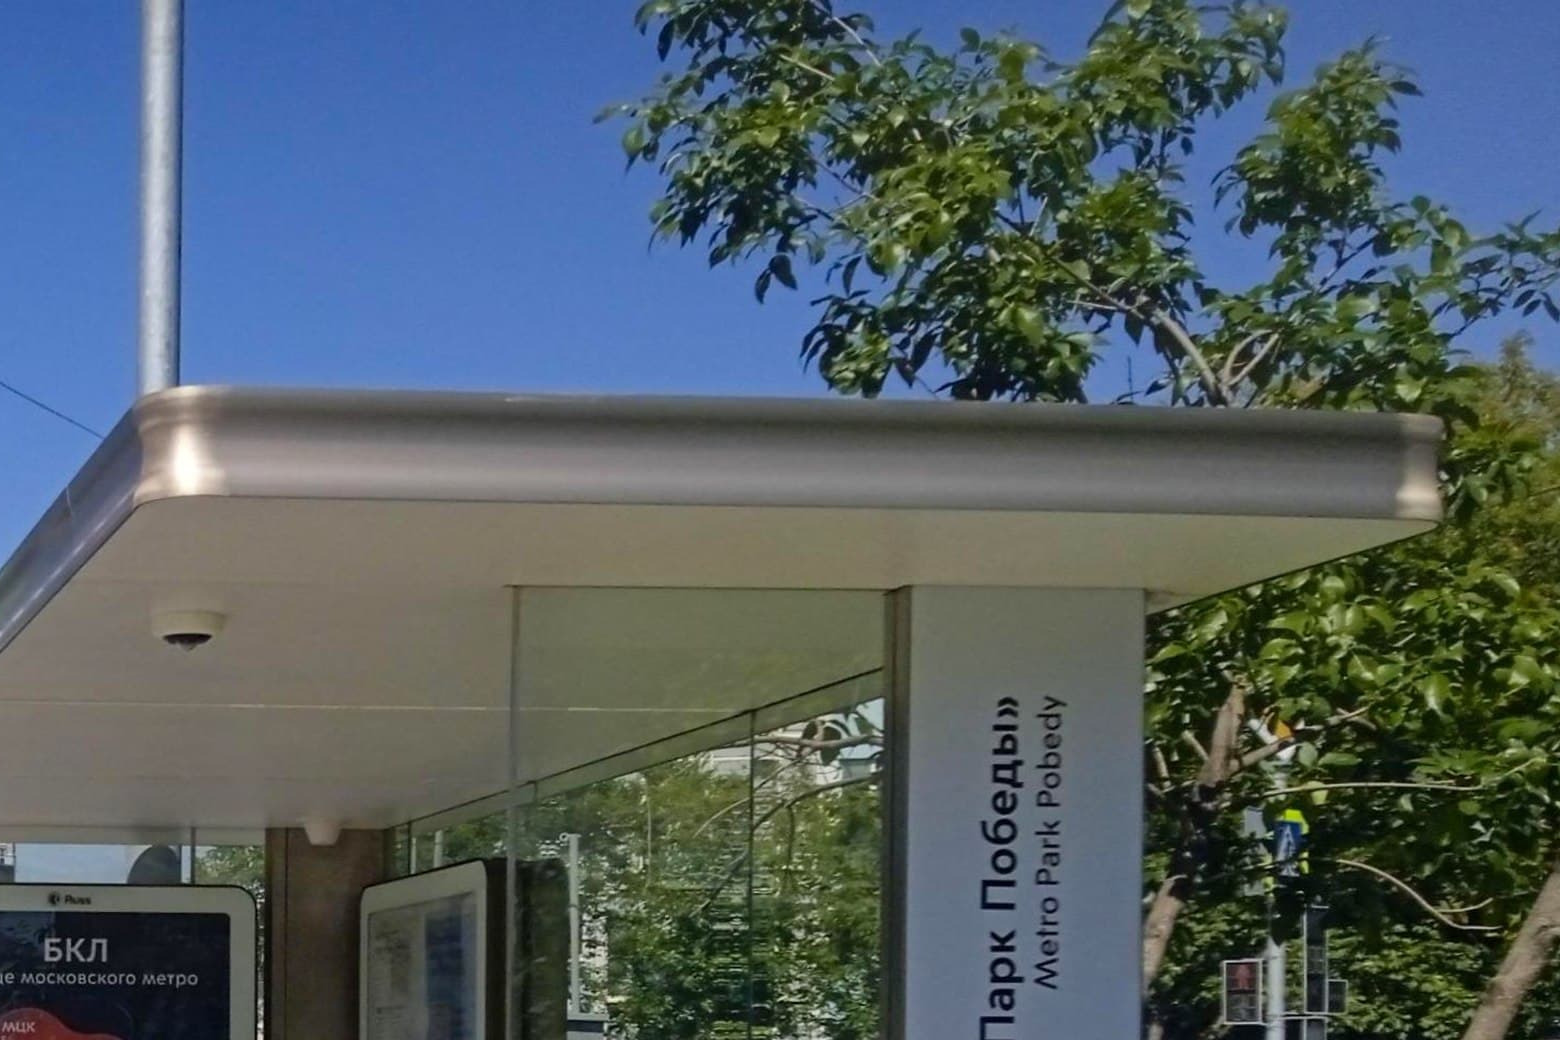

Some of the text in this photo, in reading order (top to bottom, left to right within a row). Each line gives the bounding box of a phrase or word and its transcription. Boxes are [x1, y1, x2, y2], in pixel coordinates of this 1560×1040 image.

[980, 696, 1025, 911] Победы»
[1033, 695, 1069, 990] Metro Park Pobedy
[42, 937, 109, 963] БКЛ
[20, 971, 137, 986] московского
[141, 972, 200, 989] метро
[1, 1020, 37, 1034] МЦК
